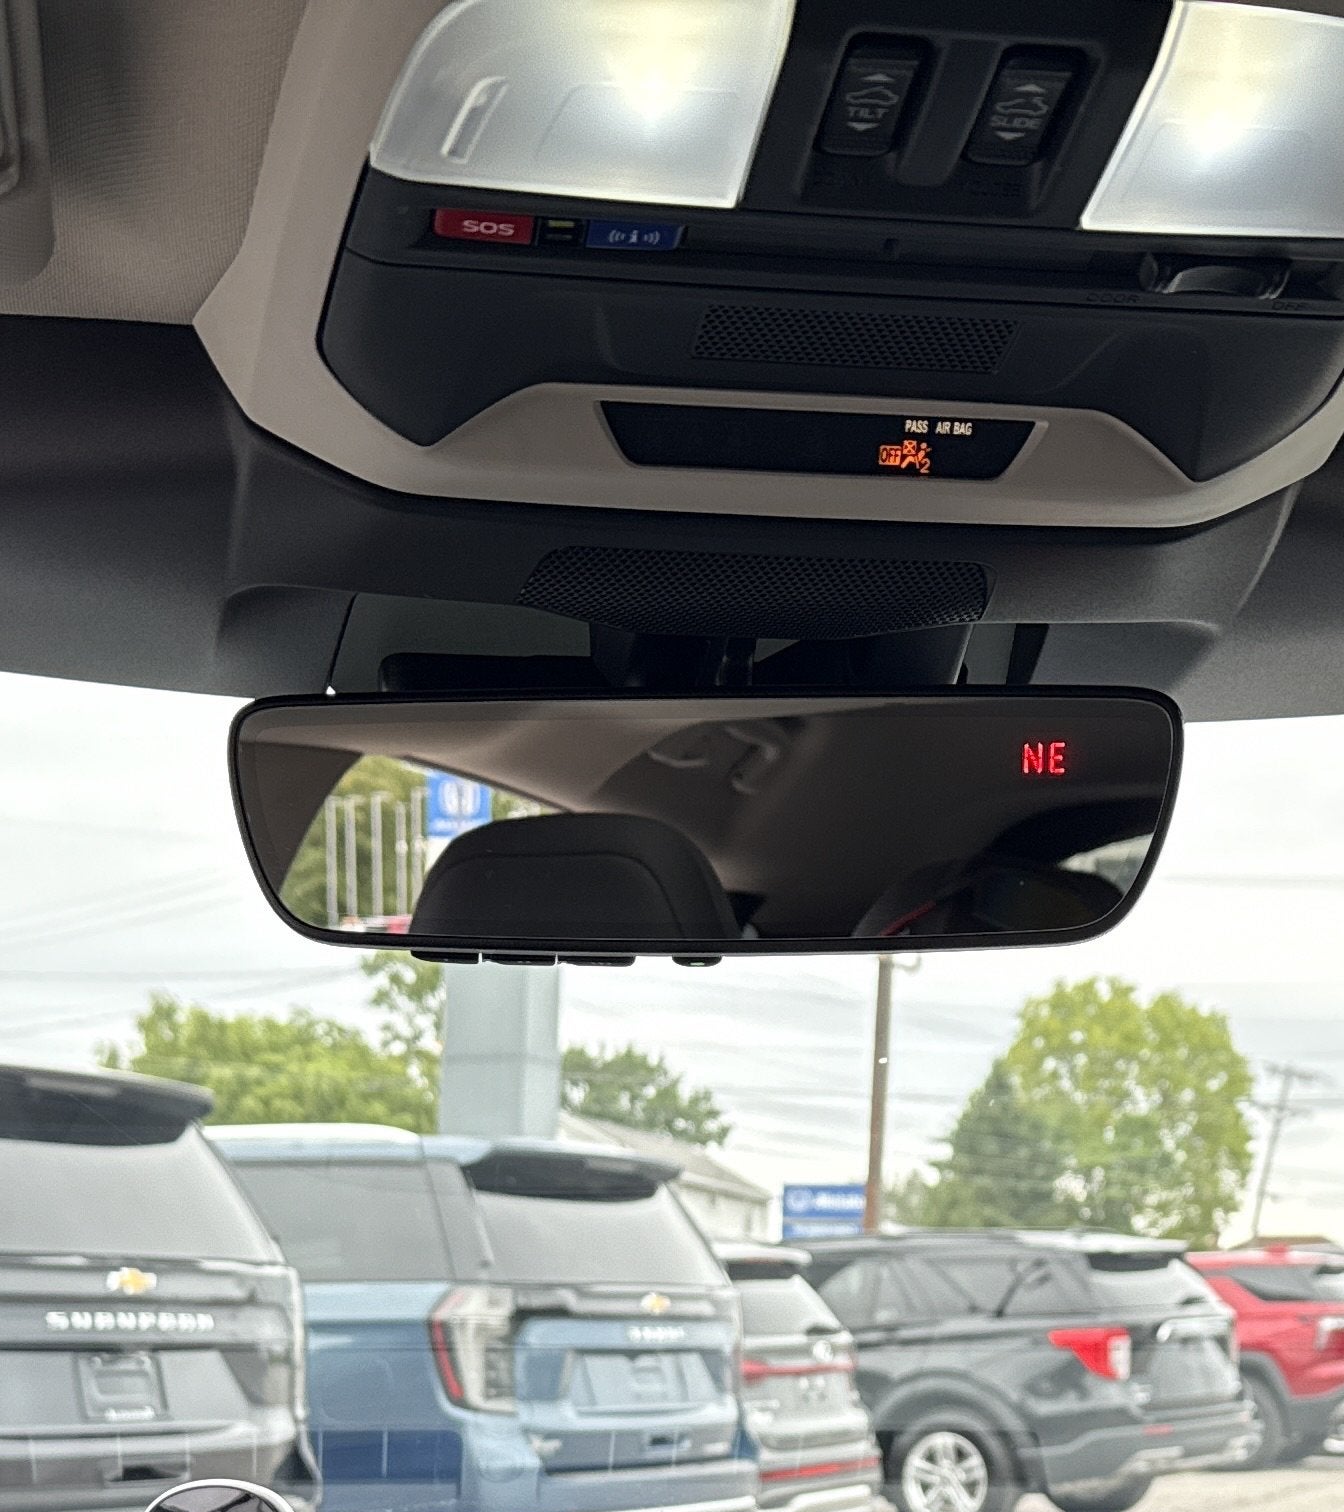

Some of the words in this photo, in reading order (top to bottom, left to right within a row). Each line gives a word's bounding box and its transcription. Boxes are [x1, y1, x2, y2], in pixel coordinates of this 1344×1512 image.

[846, 105, 888, 120] TILT
[989, 115, 1042, 130] SLIDE
[462, 218, 516, 237] SOS
[904, 419, 929, 434] PASS
[934, 421, 951, 434] AIR
[953, 421, 973, 436] BAG
[1022, 741, 1066, 774] NE
